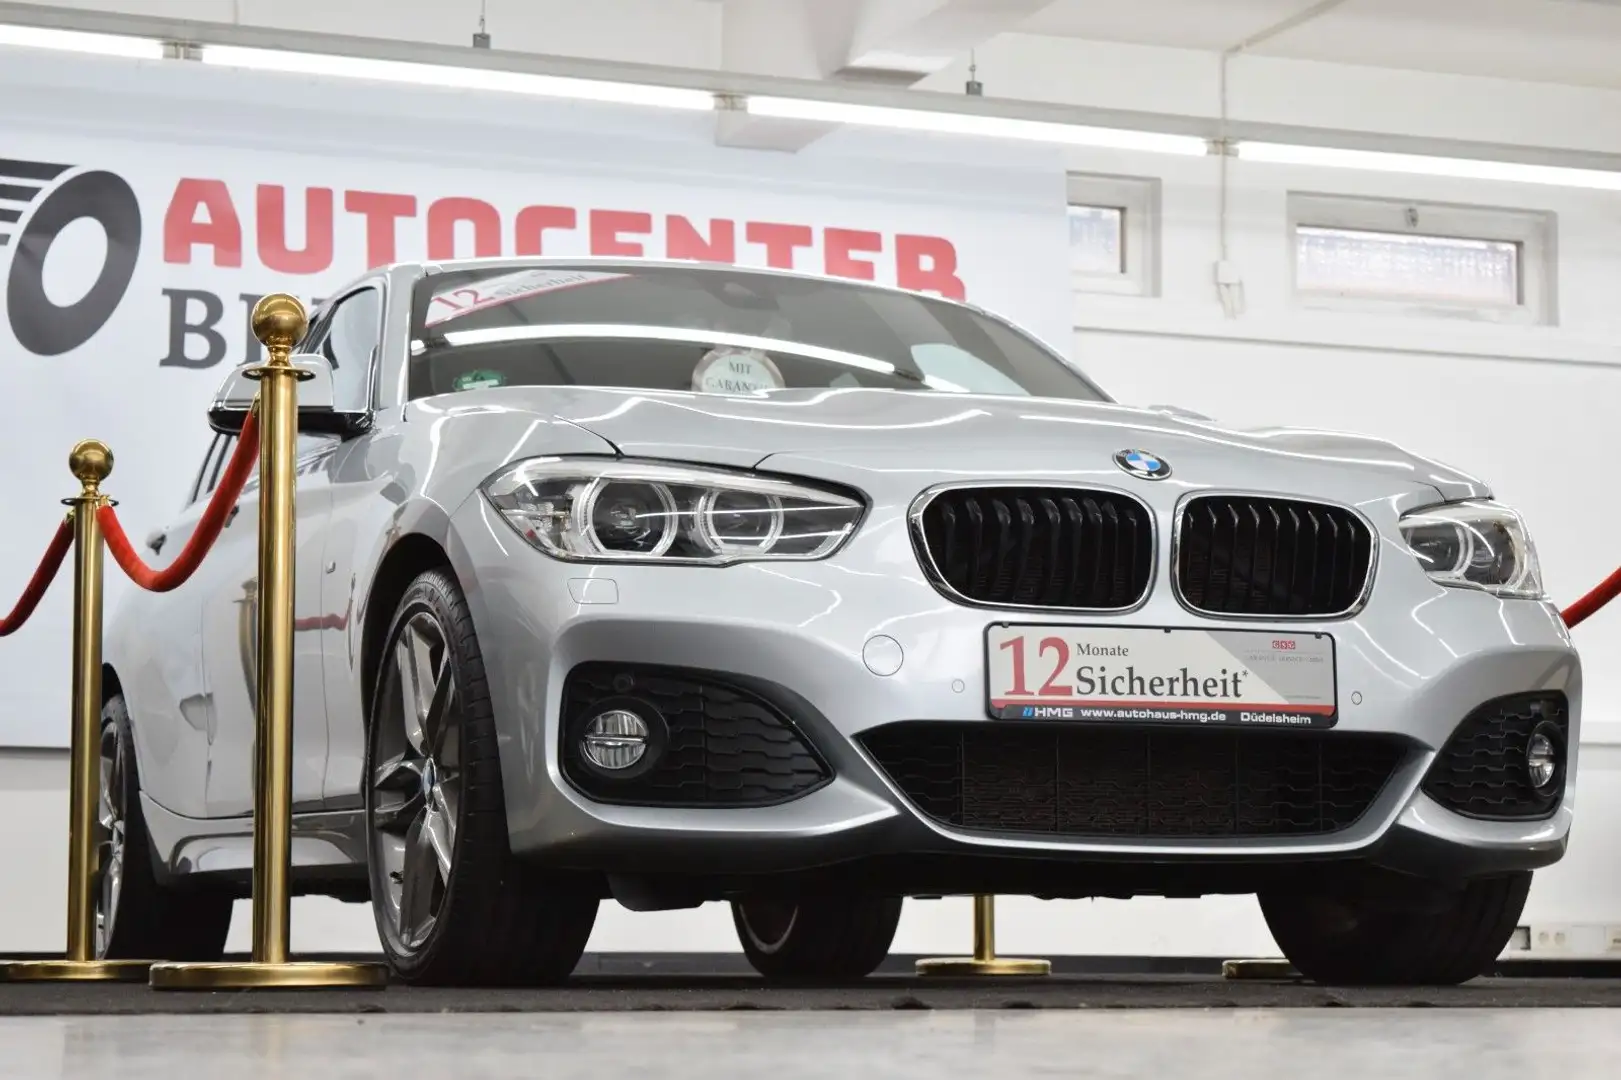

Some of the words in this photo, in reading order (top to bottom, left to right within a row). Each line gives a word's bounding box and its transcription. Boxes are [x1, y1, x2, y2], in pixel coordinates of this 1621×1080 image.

[163, 177, 967, 303] AUTOCENTER
[432, 288, 495, 310] 12
[728, 361, 752, 375] MIT
[1000, 636, 1073, 696] 12
[1076, 643, 1129, 657] Monate
[1034, 707, 1074, 718] HMG
[1081, 708, 1227, 723] www.autohaus-hmg.de
[1240, 712, 1312, 725] Düdelsheim
